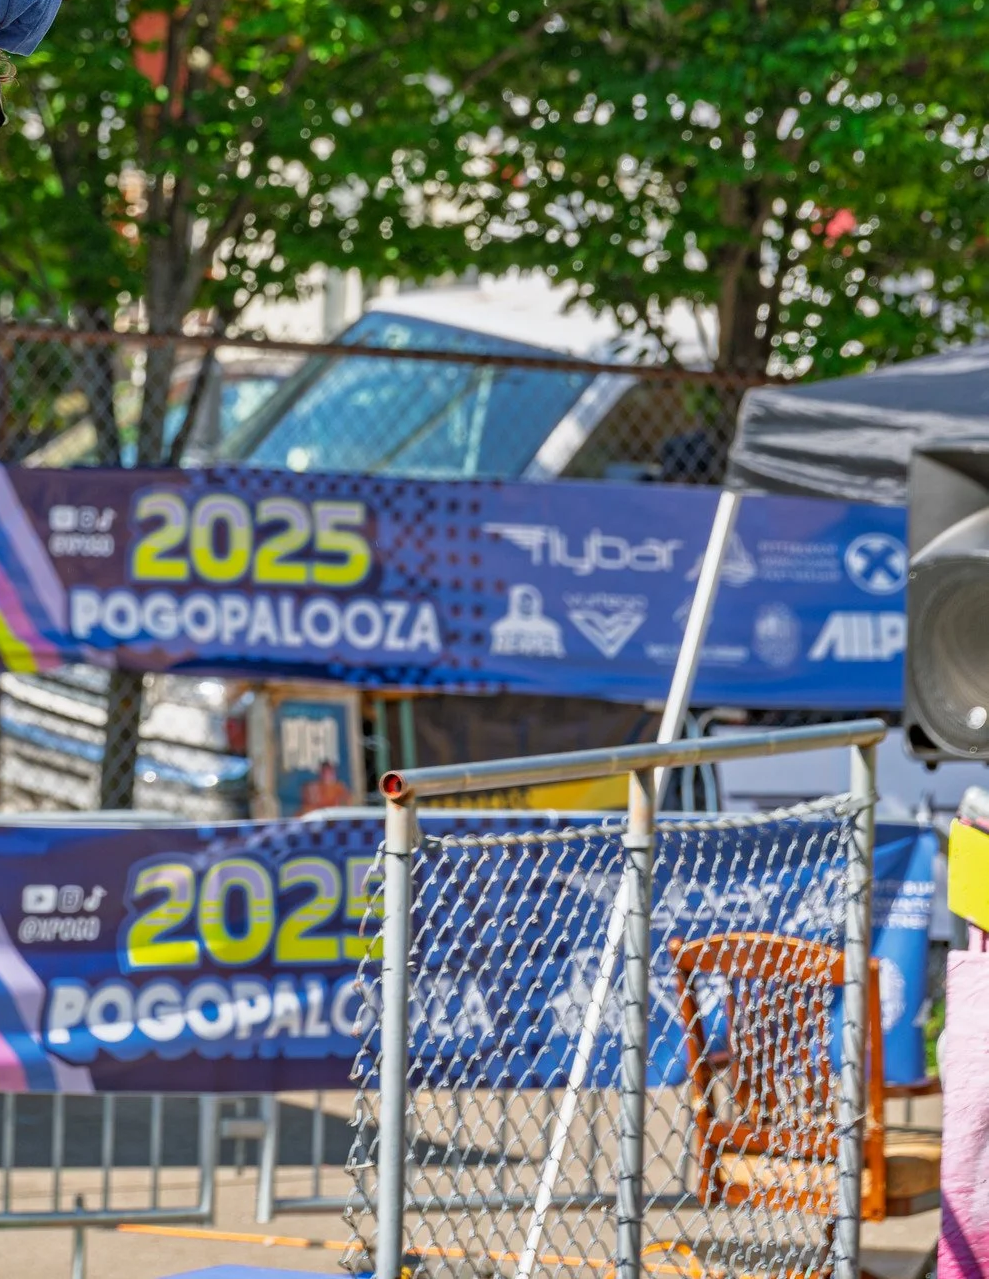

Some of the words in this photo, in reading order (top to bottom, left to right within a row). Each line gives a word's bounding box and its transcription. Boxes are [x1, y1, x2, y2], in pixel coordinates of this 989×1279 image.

[133, 493, 372, 587] 2025
[481, 522, 686, 577] flybar
[70, 588, 442, 652] POGOPALOOZA
[126, 856, 386, 967] 2025
[48, 976, 496, 1043] POGOPALOZA
